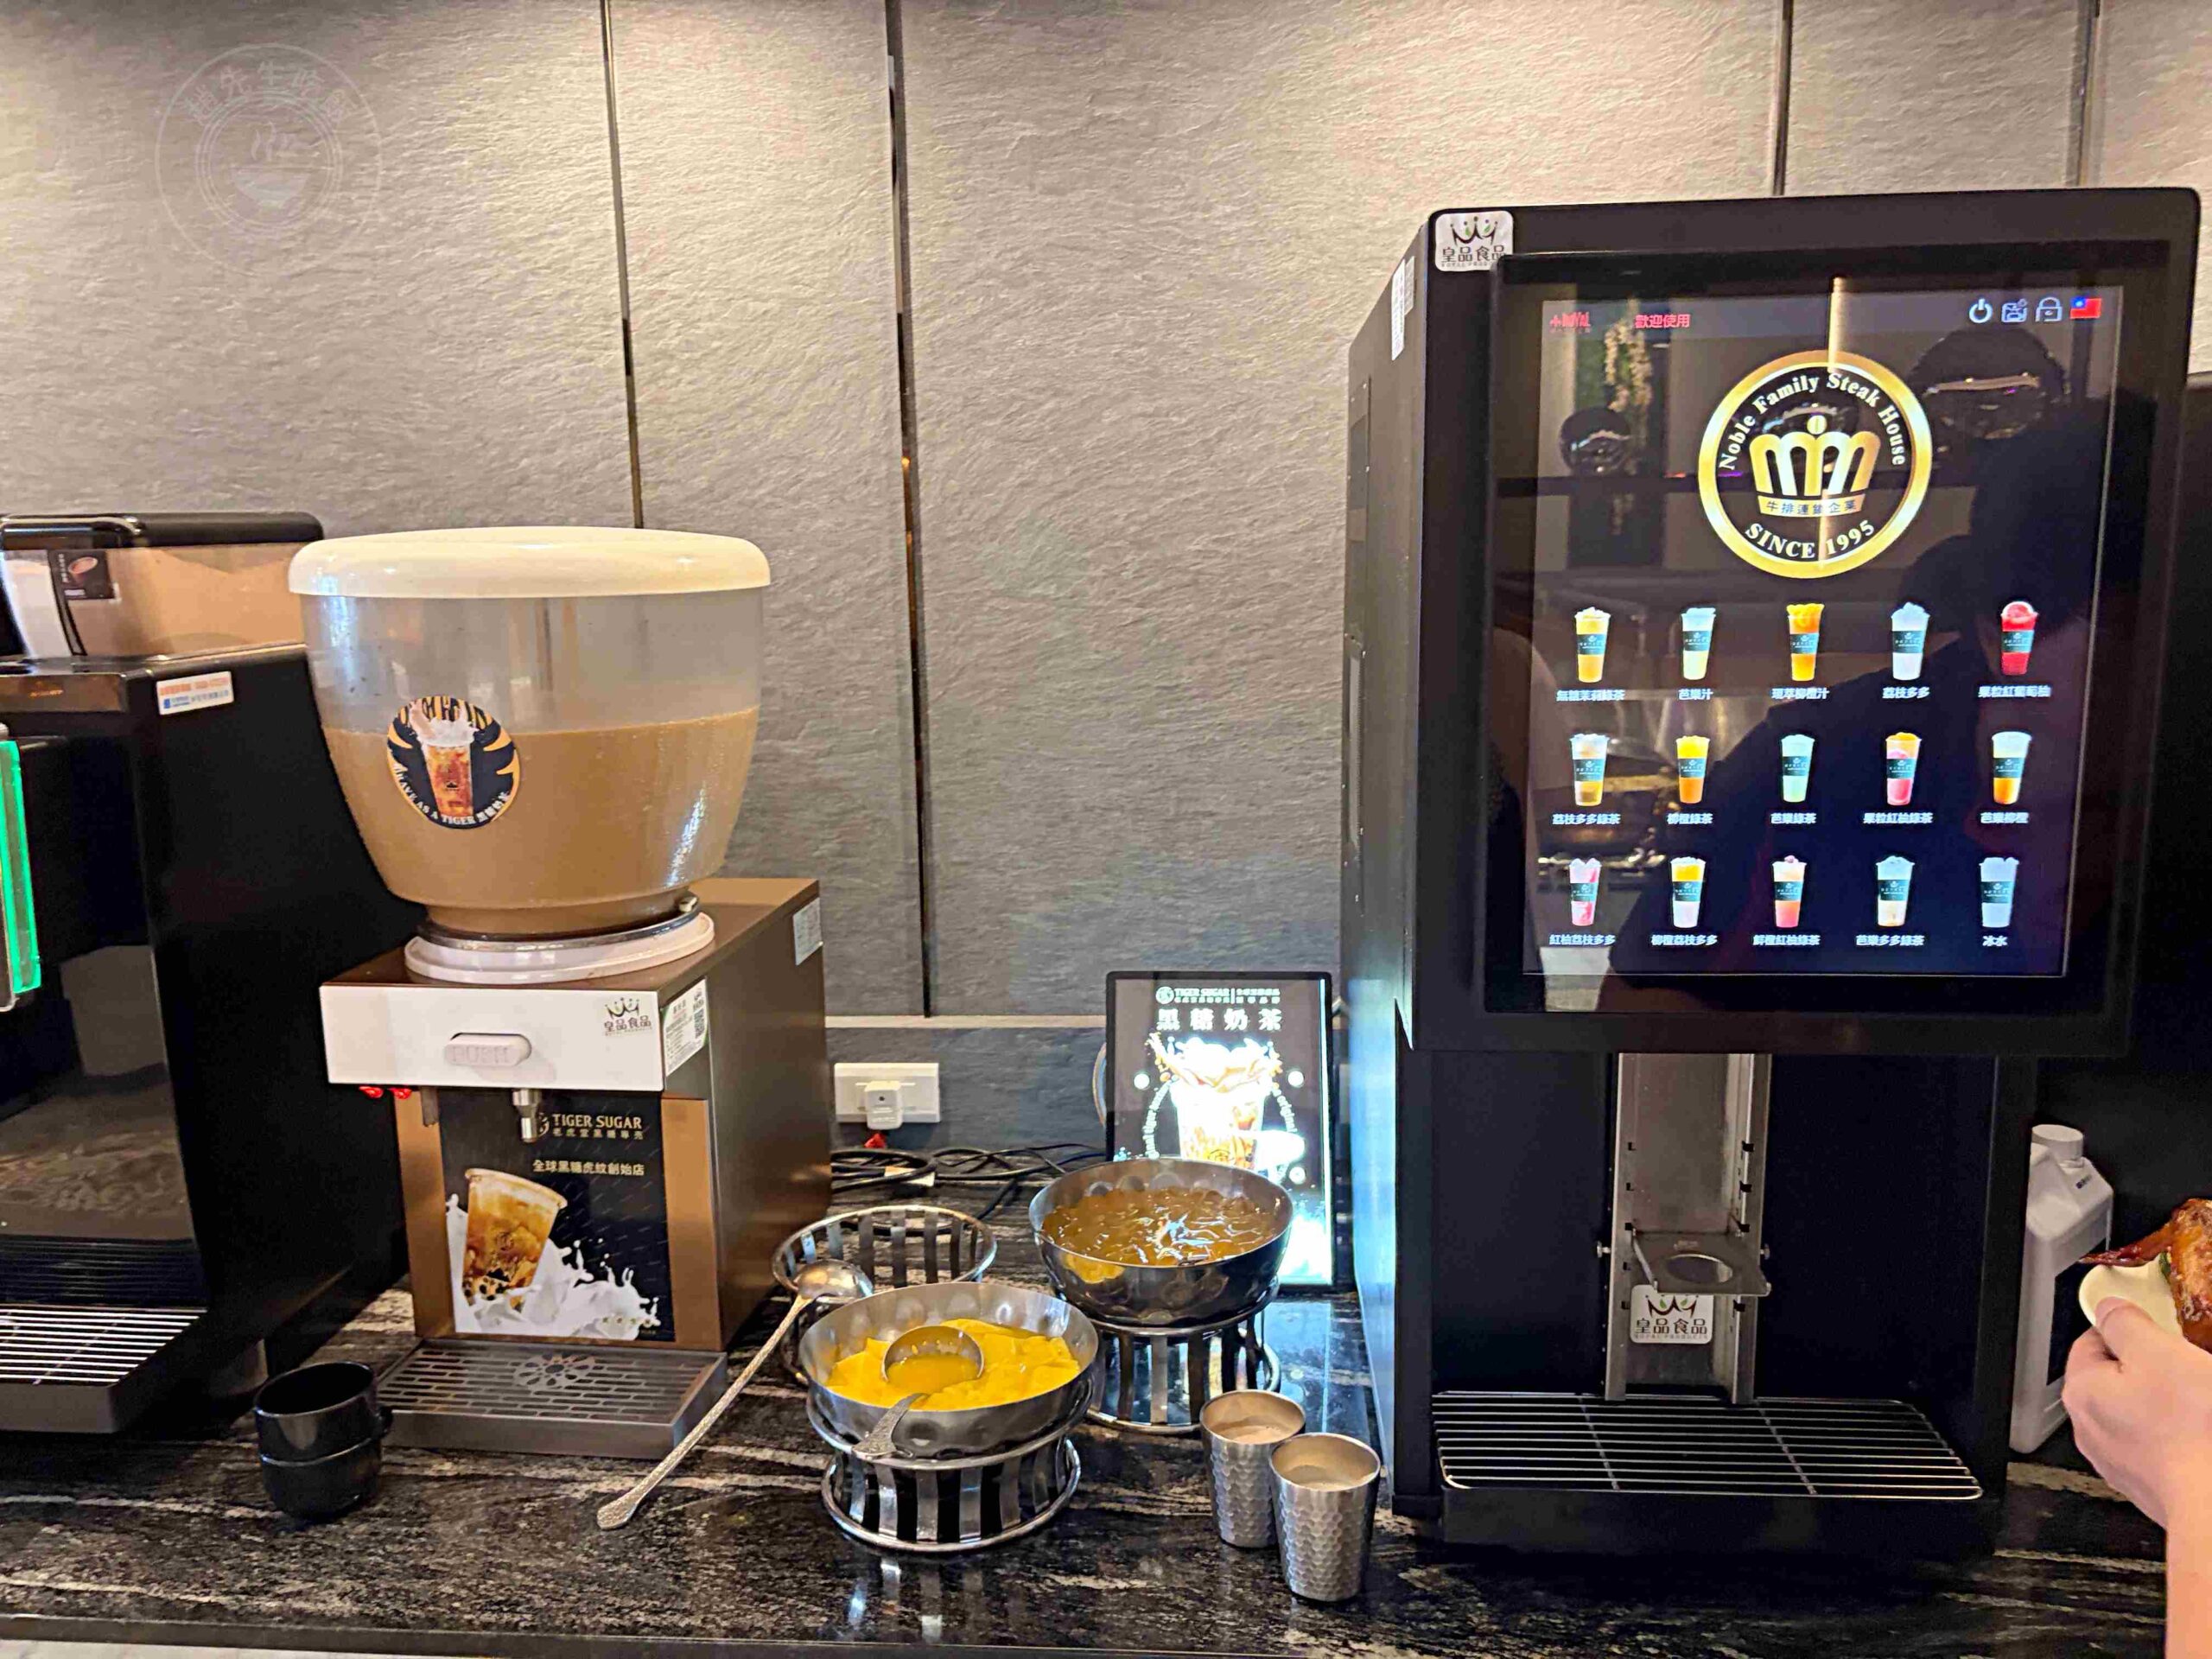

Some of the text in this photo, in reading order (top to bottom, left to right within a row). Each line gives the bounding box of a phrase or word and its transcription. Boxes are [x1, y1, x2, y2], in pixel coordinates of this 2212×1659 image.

[1441, 245, 1505, 263] 皇品食品
[1634, 314, 1691, 329] 歡迎使用
[1719, 372, 1906, 471] Noble Family Steak House
[1765, 499, 1857, 516] 牛排連鎖企業
[1745, 519, 1875, 559] SINCE 1995
[442, 814, 476, 825] TIGER
[1982, 935, 2008, 947] 冰水
[604, 1014, 652, 1033] 皇品食品
[1156, 1007, 1283, 1031] 黑糖奶茶
[448, 1046, 512, 1064] PUSH
[552, 1113, 642, 1129] TIGER SUGAR
[532, 1159, 645, 1177] 全球黑糖虎紋創始店
[1635, 1318, 1708, 1334] 皇品食品
